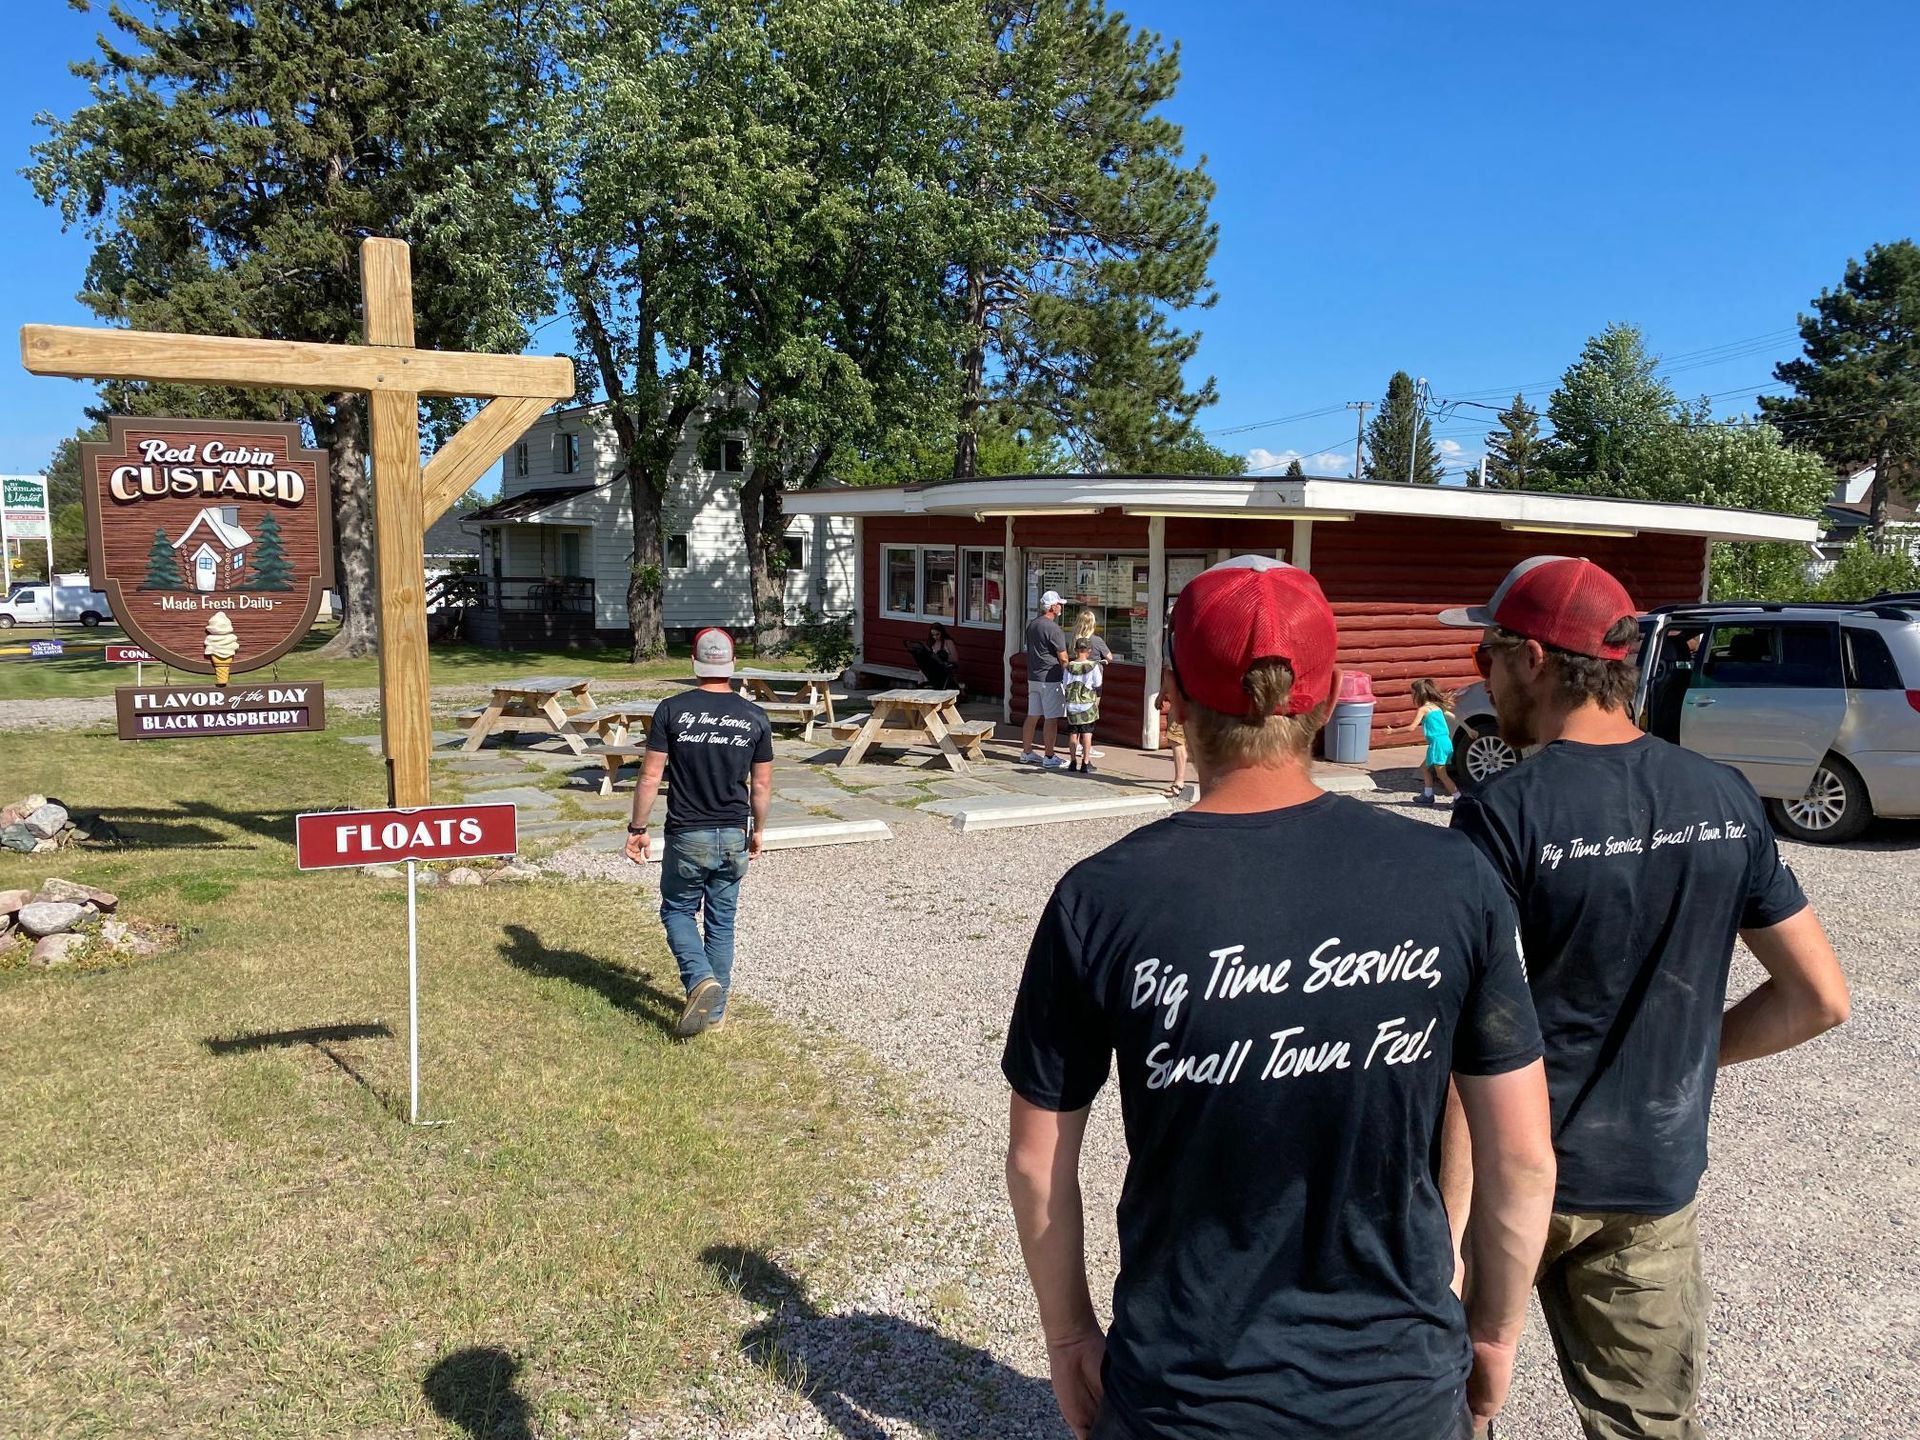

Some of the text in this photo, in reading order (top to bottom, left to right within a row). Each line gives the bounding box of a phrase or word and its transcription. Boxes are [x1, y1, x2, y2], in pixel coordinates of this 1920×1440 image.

[139, 439, 275, 466] Red Cabin
[110, 465, 306, 503] CUSTARD
[201, 595, 235, 609] Fresh
[119, 650, 155, 659] CONE
[134, 687, 309, 709] FLAVOR of the DAY
[142, 710, 300, 730] BLACK RASPBERRY
[678, 711, 752, 732] Big Time Service,
[676, 731, 751, 747] Small Town Feel.
[335, 817, 483, 853] FLOATS
[1540, 820, 1748, 870] Big Time Service, Small Town Feel.
[1130, 936, 1442, 1030] Big Time Service,
[1145, 1016, 1437, 1090] Small Town Feel.
